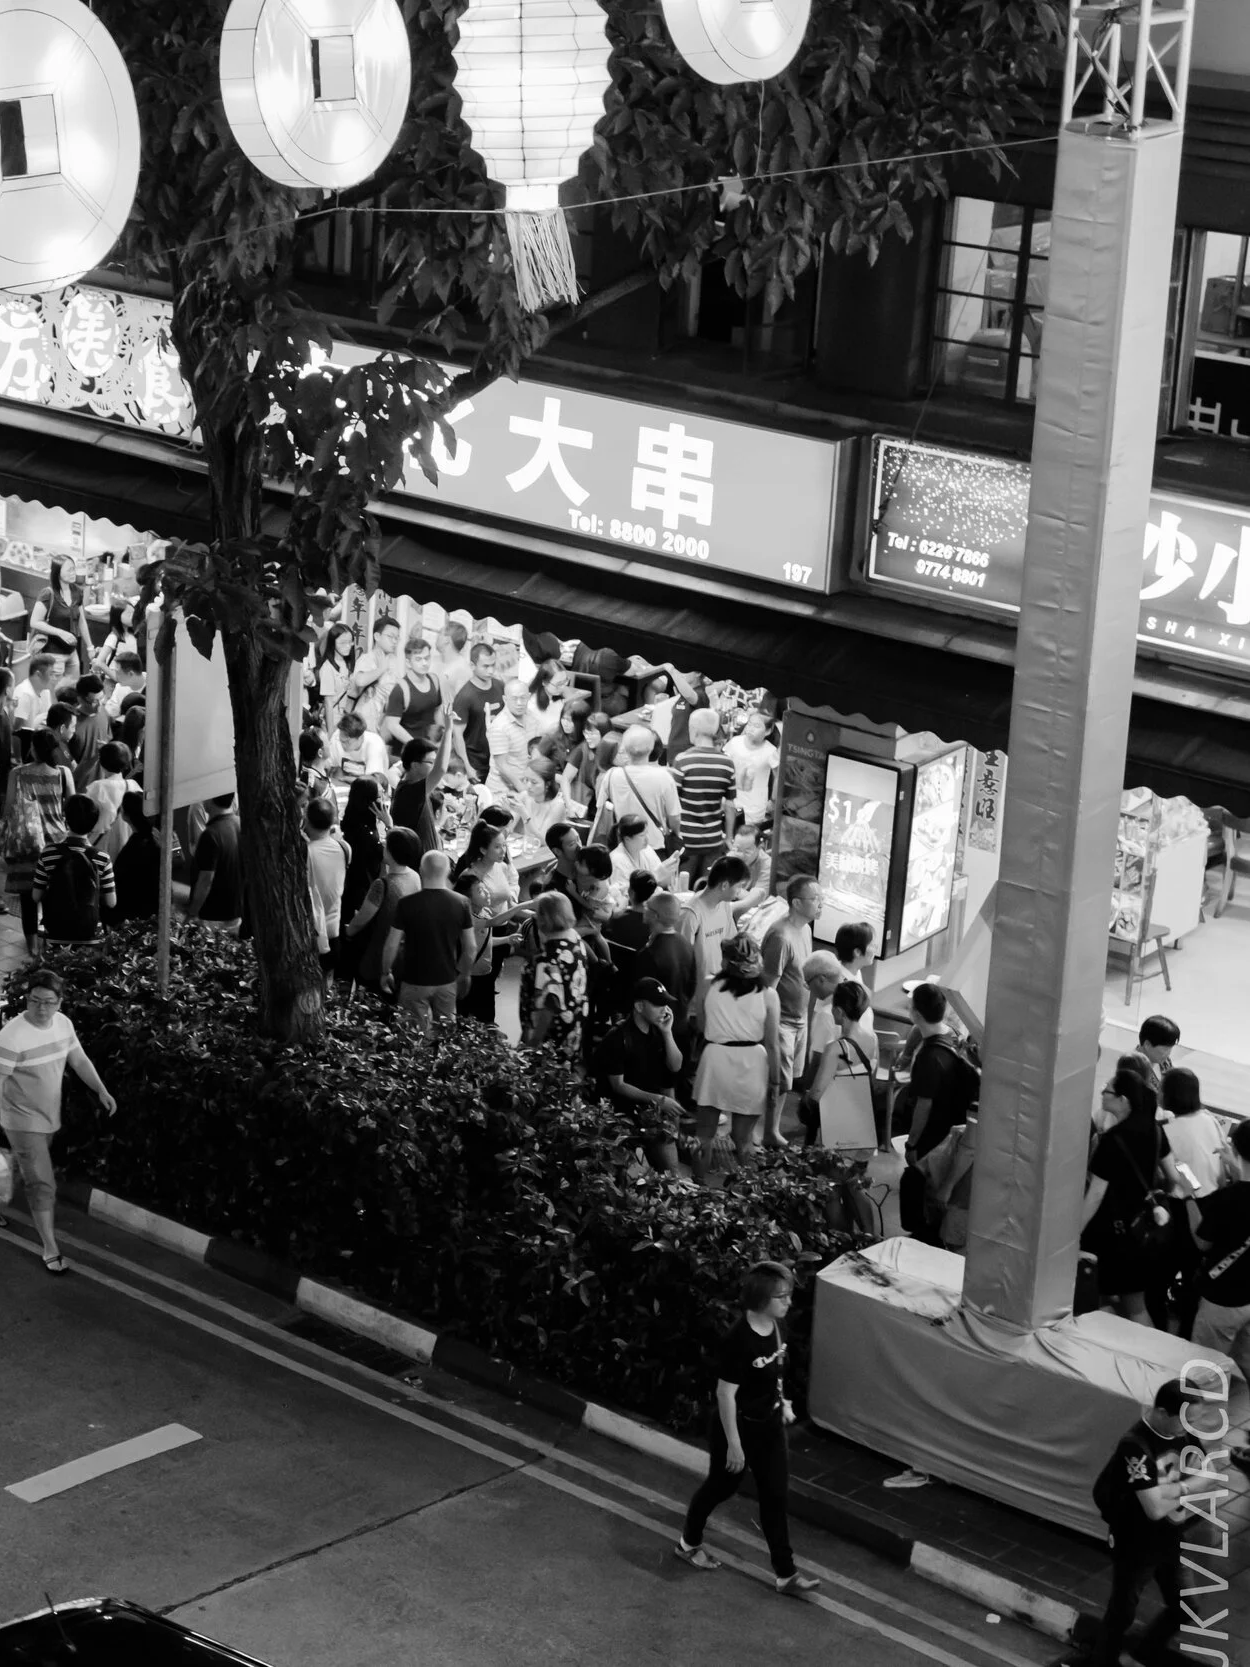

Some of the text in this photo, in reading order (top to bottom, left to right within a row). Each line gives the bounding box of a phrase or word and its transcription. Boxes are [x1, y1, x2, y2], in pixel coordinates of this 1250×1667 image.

[568, 508, 710, 560] Tel: 8800 2000
[782, 562, 813, 584] 197
[1146, 616, 1196, 640] SHA
[788, 743, 828, 760] TSINGTA
